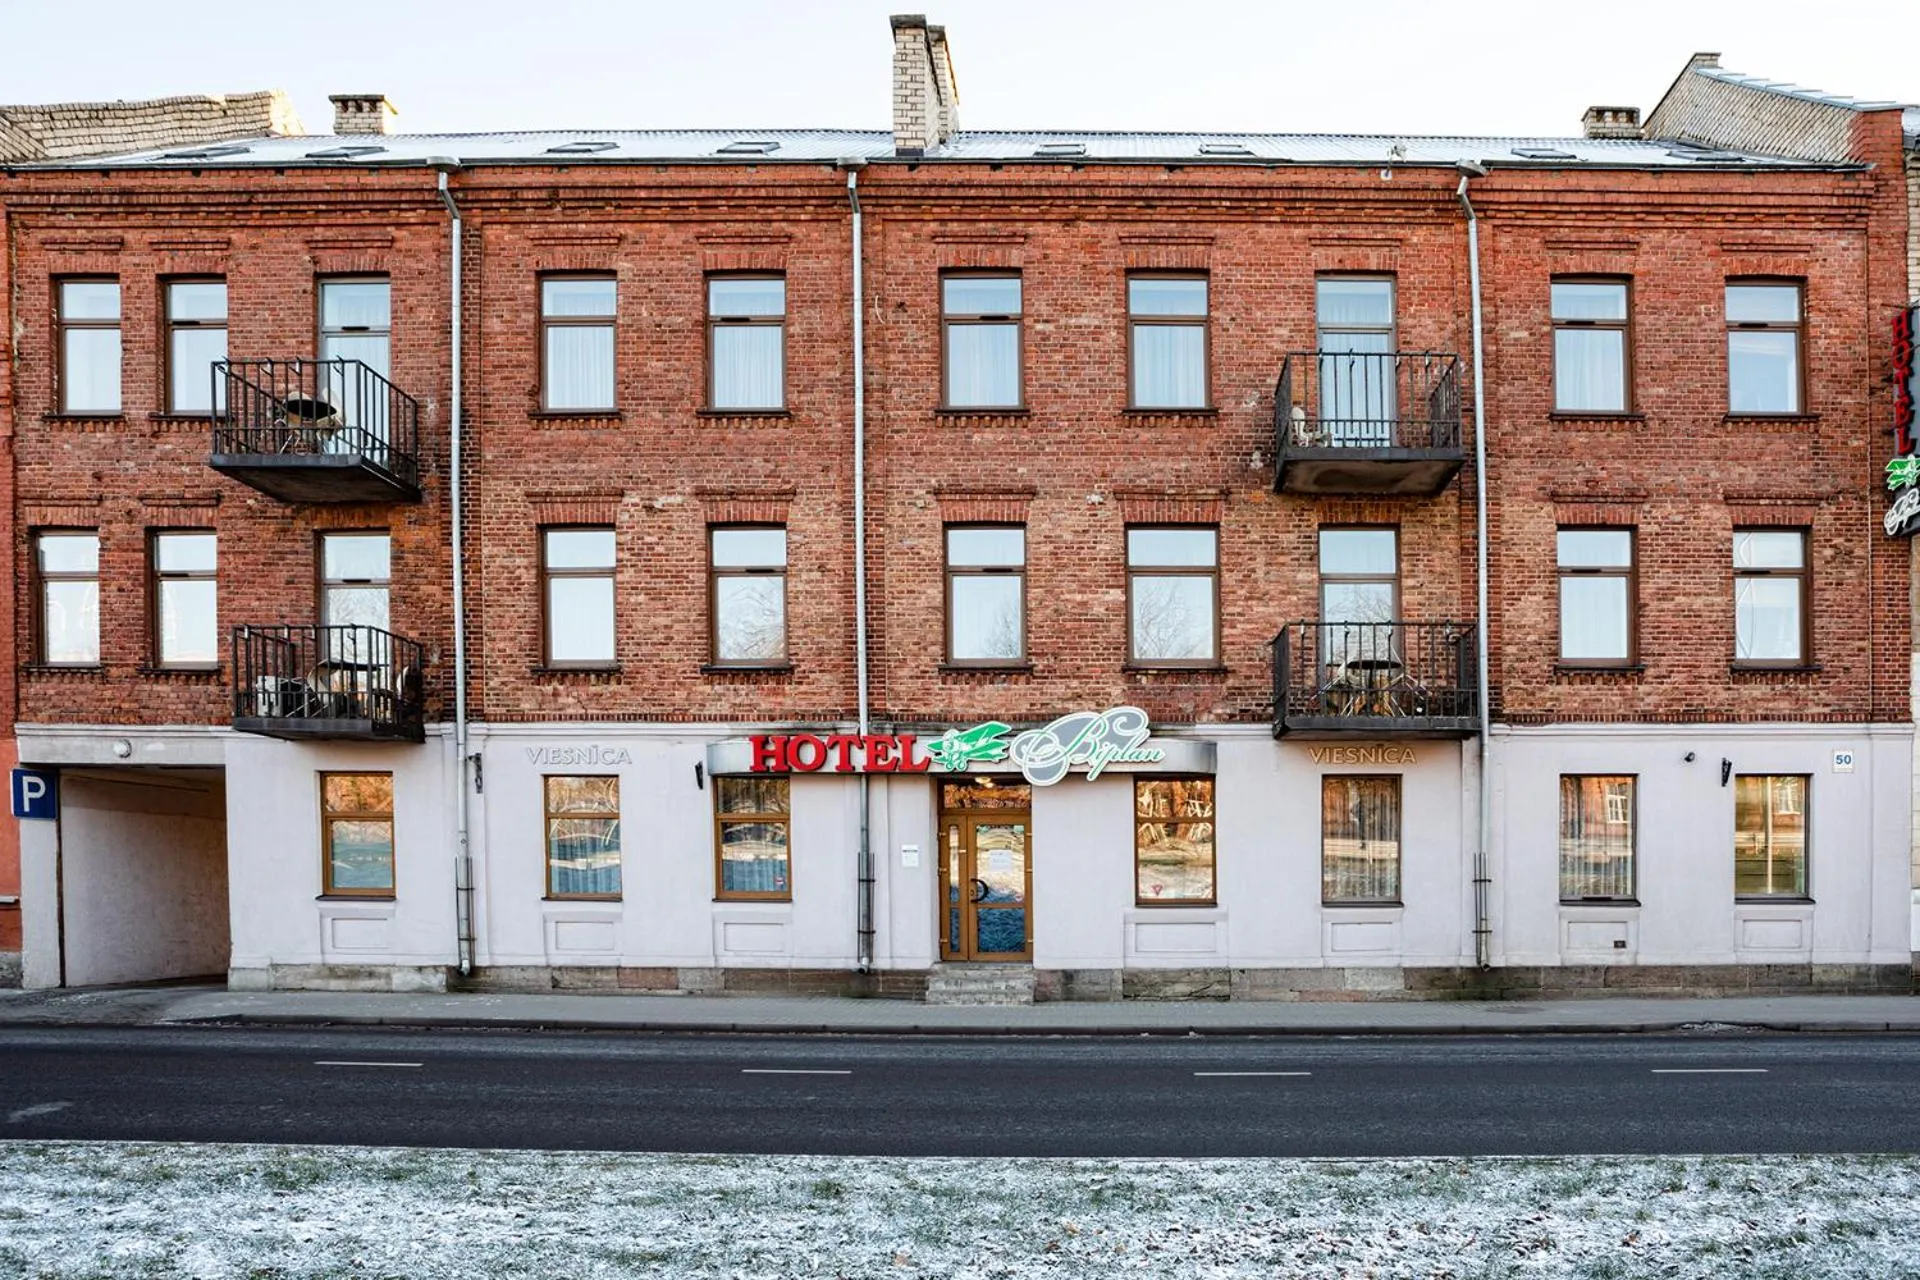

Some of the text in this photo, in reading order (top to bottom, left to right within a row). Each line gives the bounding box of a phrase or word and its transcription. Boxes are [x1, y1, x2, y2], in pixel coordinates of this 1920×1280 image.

[1891, 310, 1913, 455] HOTEL
[526, 744, 633, 766] VIESNĪCA
[749, 706, 1166, 786] HOTEL Biplan
[1308, 743, 1417, 764] VIESNĪCA
[1835, 754, 1852, 765] 50
[22, 775, 46, 812] P
